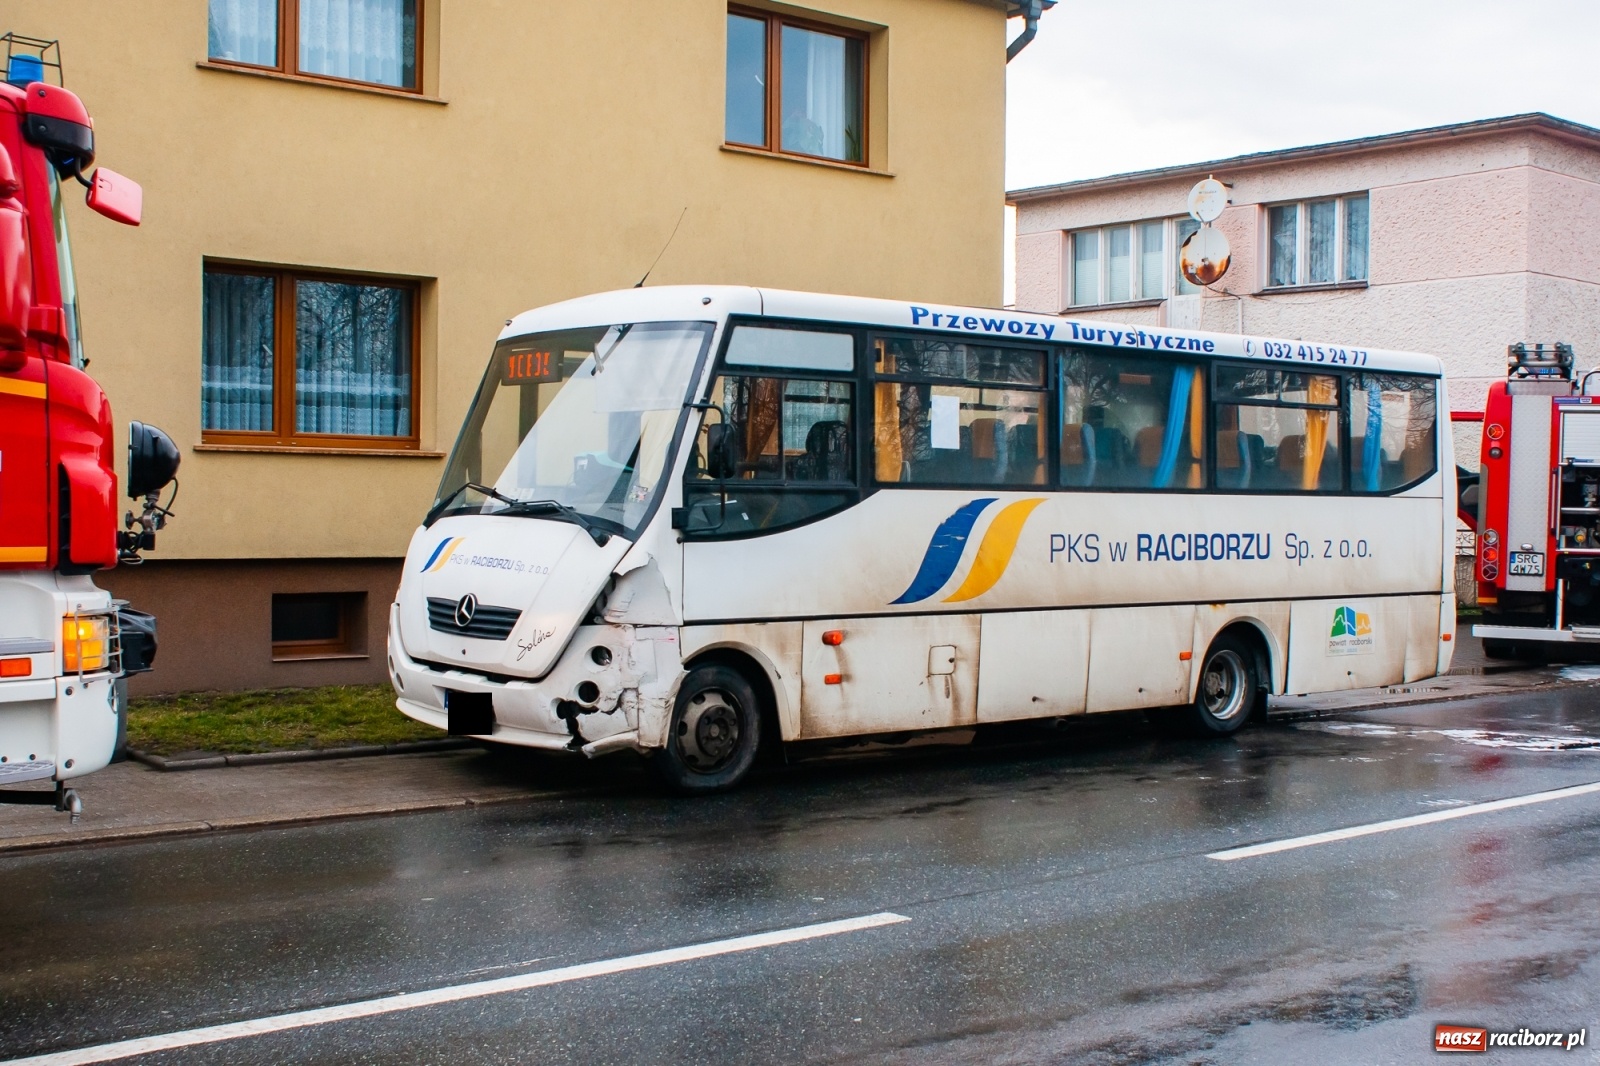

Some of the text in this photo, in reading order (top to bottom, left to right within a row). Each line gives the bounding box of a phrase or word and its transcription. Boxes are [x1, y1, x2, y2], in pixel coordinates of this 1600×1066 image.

[910, 306, 1367, 366] Przewozy Turystyczne 032 415 24 77
[1050, 533, 1373, 566] PKS w RACIBORZU Sp. z o.o.
[1517, 554, 1538, 563] SRC
[450, 553, 464, 565] PKS
[471, 556, 515, 570] RACIBORZU
[515, 560, 526, 574] Sp.
[535, 566, 550, 575] o.o.
